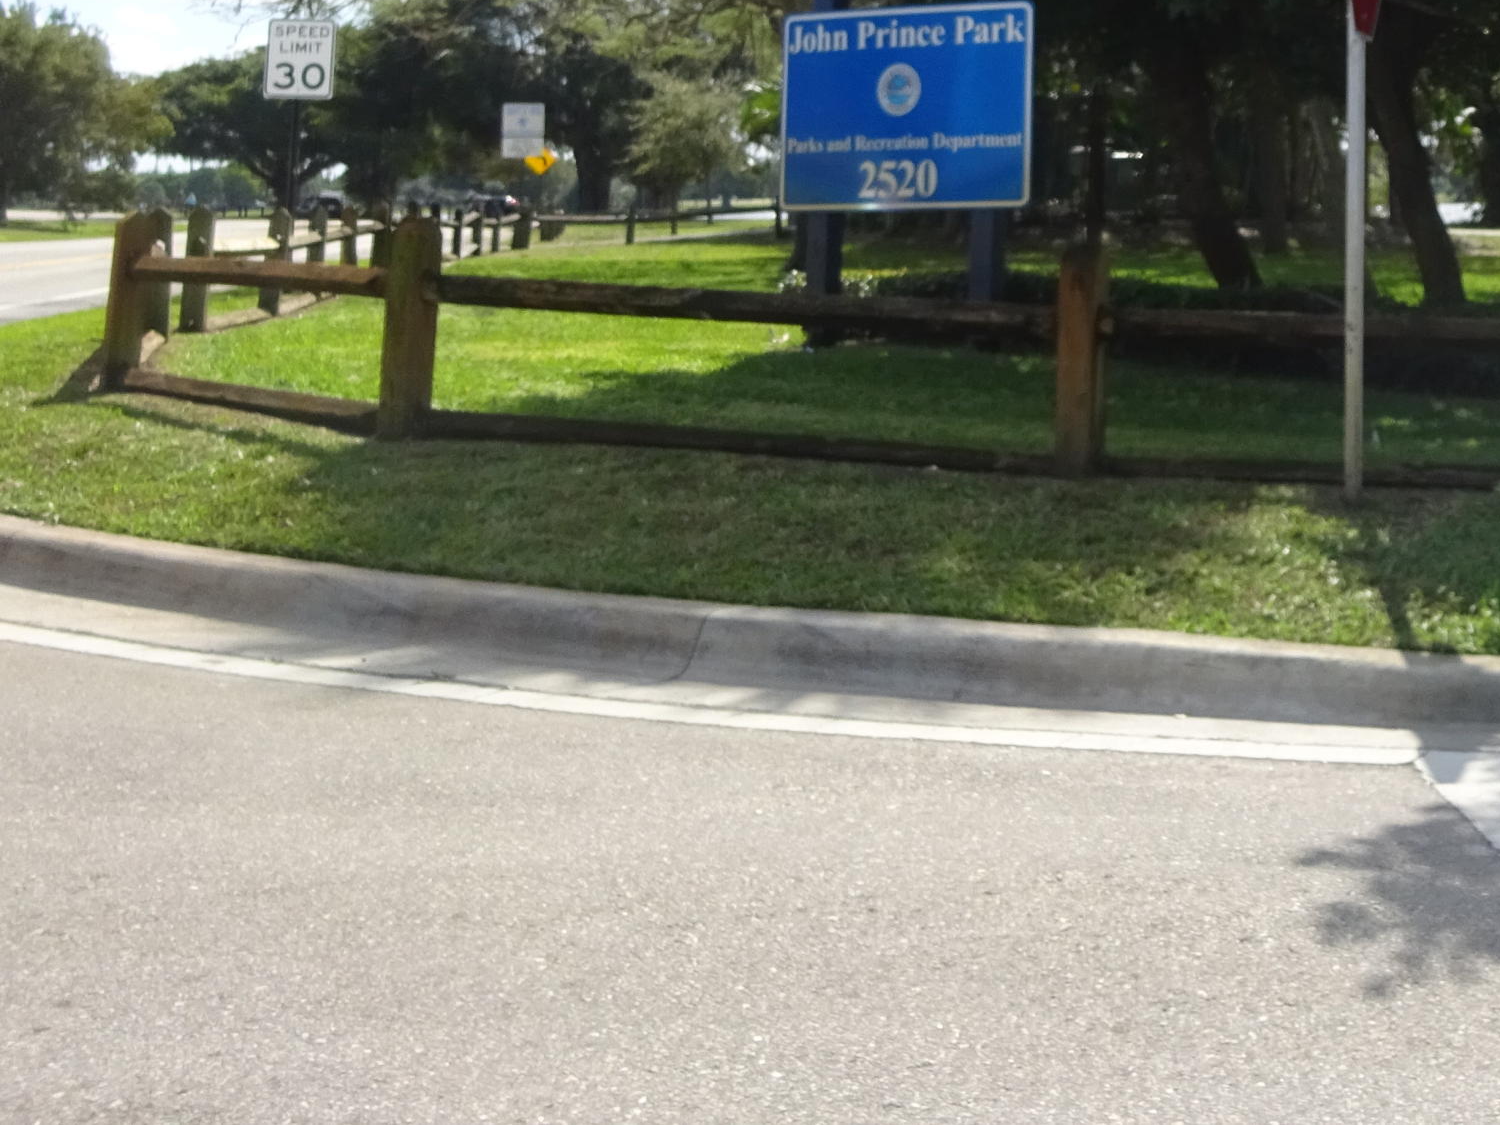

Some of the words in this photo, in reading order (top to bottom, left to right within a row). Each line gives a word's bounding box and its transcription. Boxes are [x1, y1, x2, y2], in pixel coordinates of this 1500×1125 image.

[276, 25, 330, 38] SPEED
[789, 24, 849, 55] John
[856, 20, 946, 50] Prince
[954, 14, 1025, 45] Park
[279, 42, 322, 53] LIMIT
[274, 62, 325, 90] 30
[787, 137, 824, 154] Parks
[827, 136, 851, 151] and
[855, 134, 929, 151] Recreation
[932, 131, 1022, 152] Department
[858, 159, 938, 198] 2520
